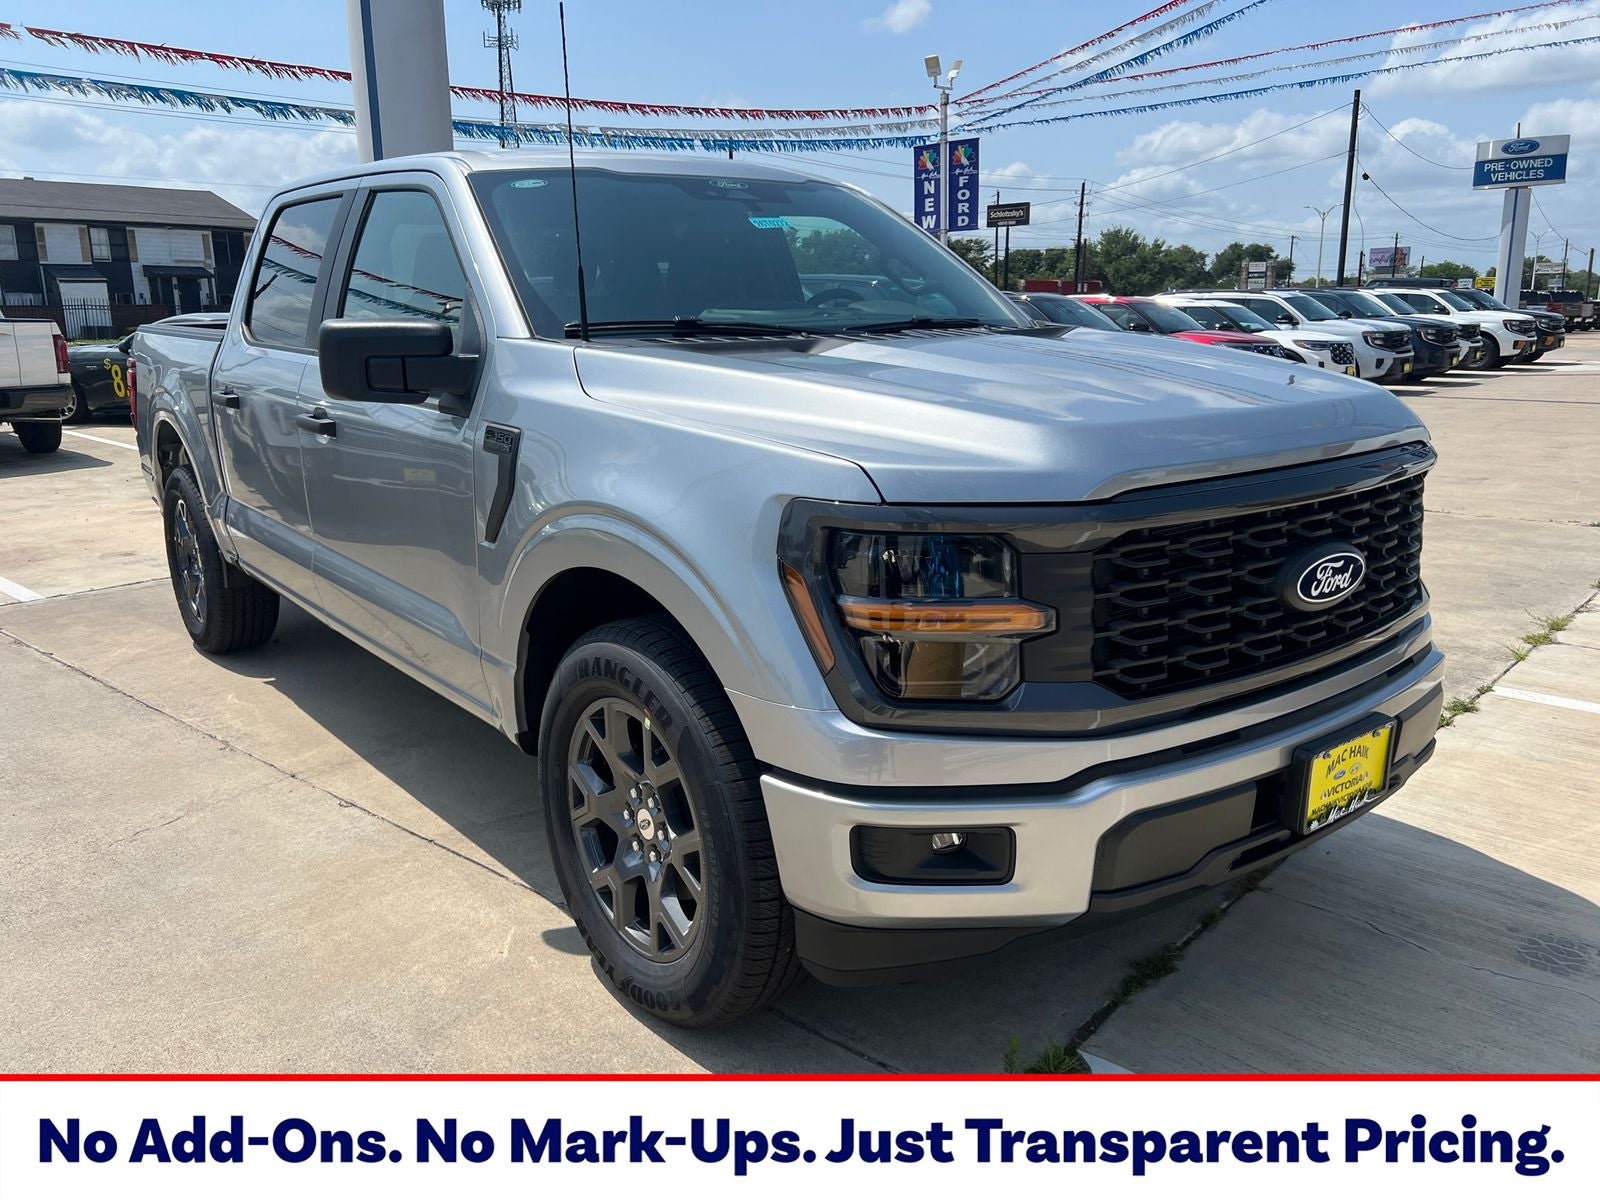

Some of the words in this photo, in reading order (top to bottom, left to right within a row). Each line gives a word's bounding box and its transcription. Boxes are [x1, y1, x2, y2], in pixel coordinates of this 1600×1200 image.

[1508, 142, 1531, 152] Ford
[1491, 169, 1544, 182] VEHICLES
[921, 180, 937, 229] NEW
[957, 175, 971, 227] FORD
[1311, 559, 1354, 597] Ford
[1326, 748, 1348, 778] MAC
[1349, 744, 1370, 760] HAIK
[1326, 776, 1364, 798] VICTORIA
